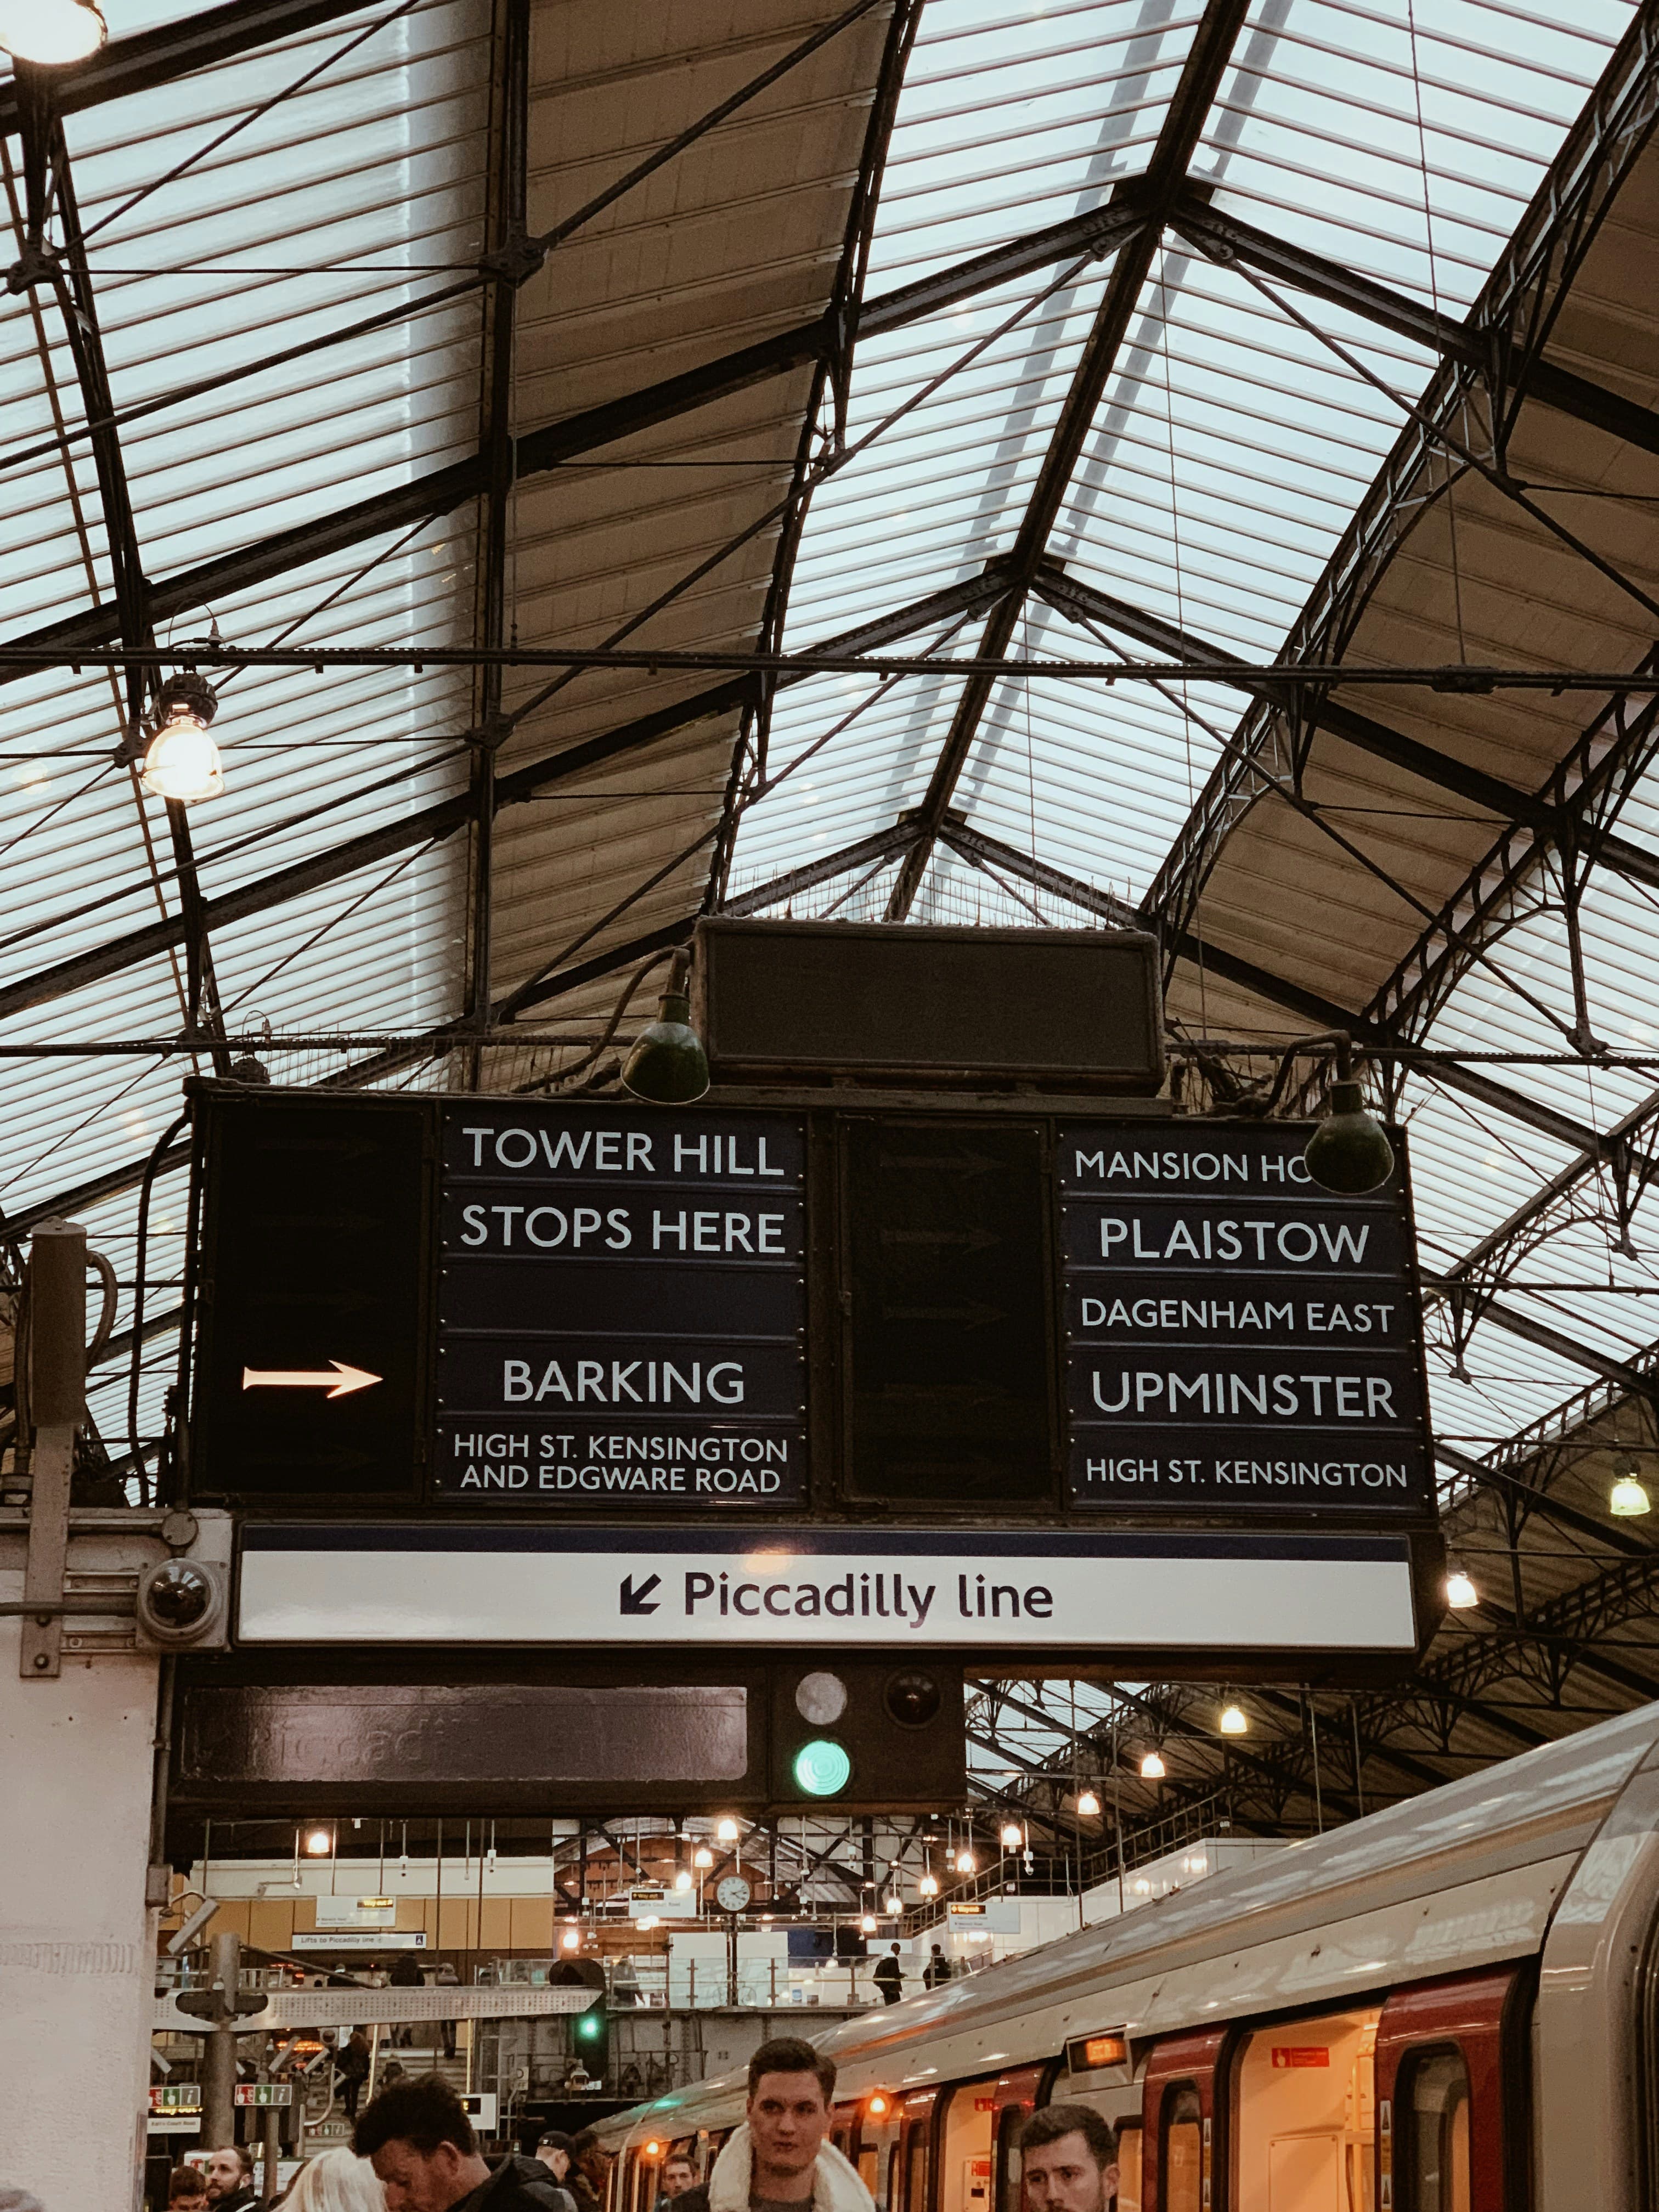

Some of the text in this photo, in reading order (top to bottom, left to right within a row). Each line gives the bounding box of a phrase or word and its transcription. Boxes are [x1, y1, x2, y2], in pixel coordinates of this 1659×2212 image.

[463, 1128, 784, 1175] TOWER HILL
[1076, 1150, 1312, 1183] MANSION HO
[461, 1205, 785, 1253] STOPS HERE
[1101, 1218, 1369, 1263] PLAISTOW
[1082, 1299, 1394, 1332] DAGENHAM EAST
[501, 1361, 744, 1403] BARKING
[1093, 1372, 1397, 1418] UPMINSTER
[455, 1434, 787, 1462] HIGH ST. KENSINGTON
[461, 1465, 780, 1492] AND EDGWARE ROAD
[1087, 1459, 1407, 1487] HIGH ST. KENSINGTON
[686, 1572, 1053, 1629] Piccadilly line
